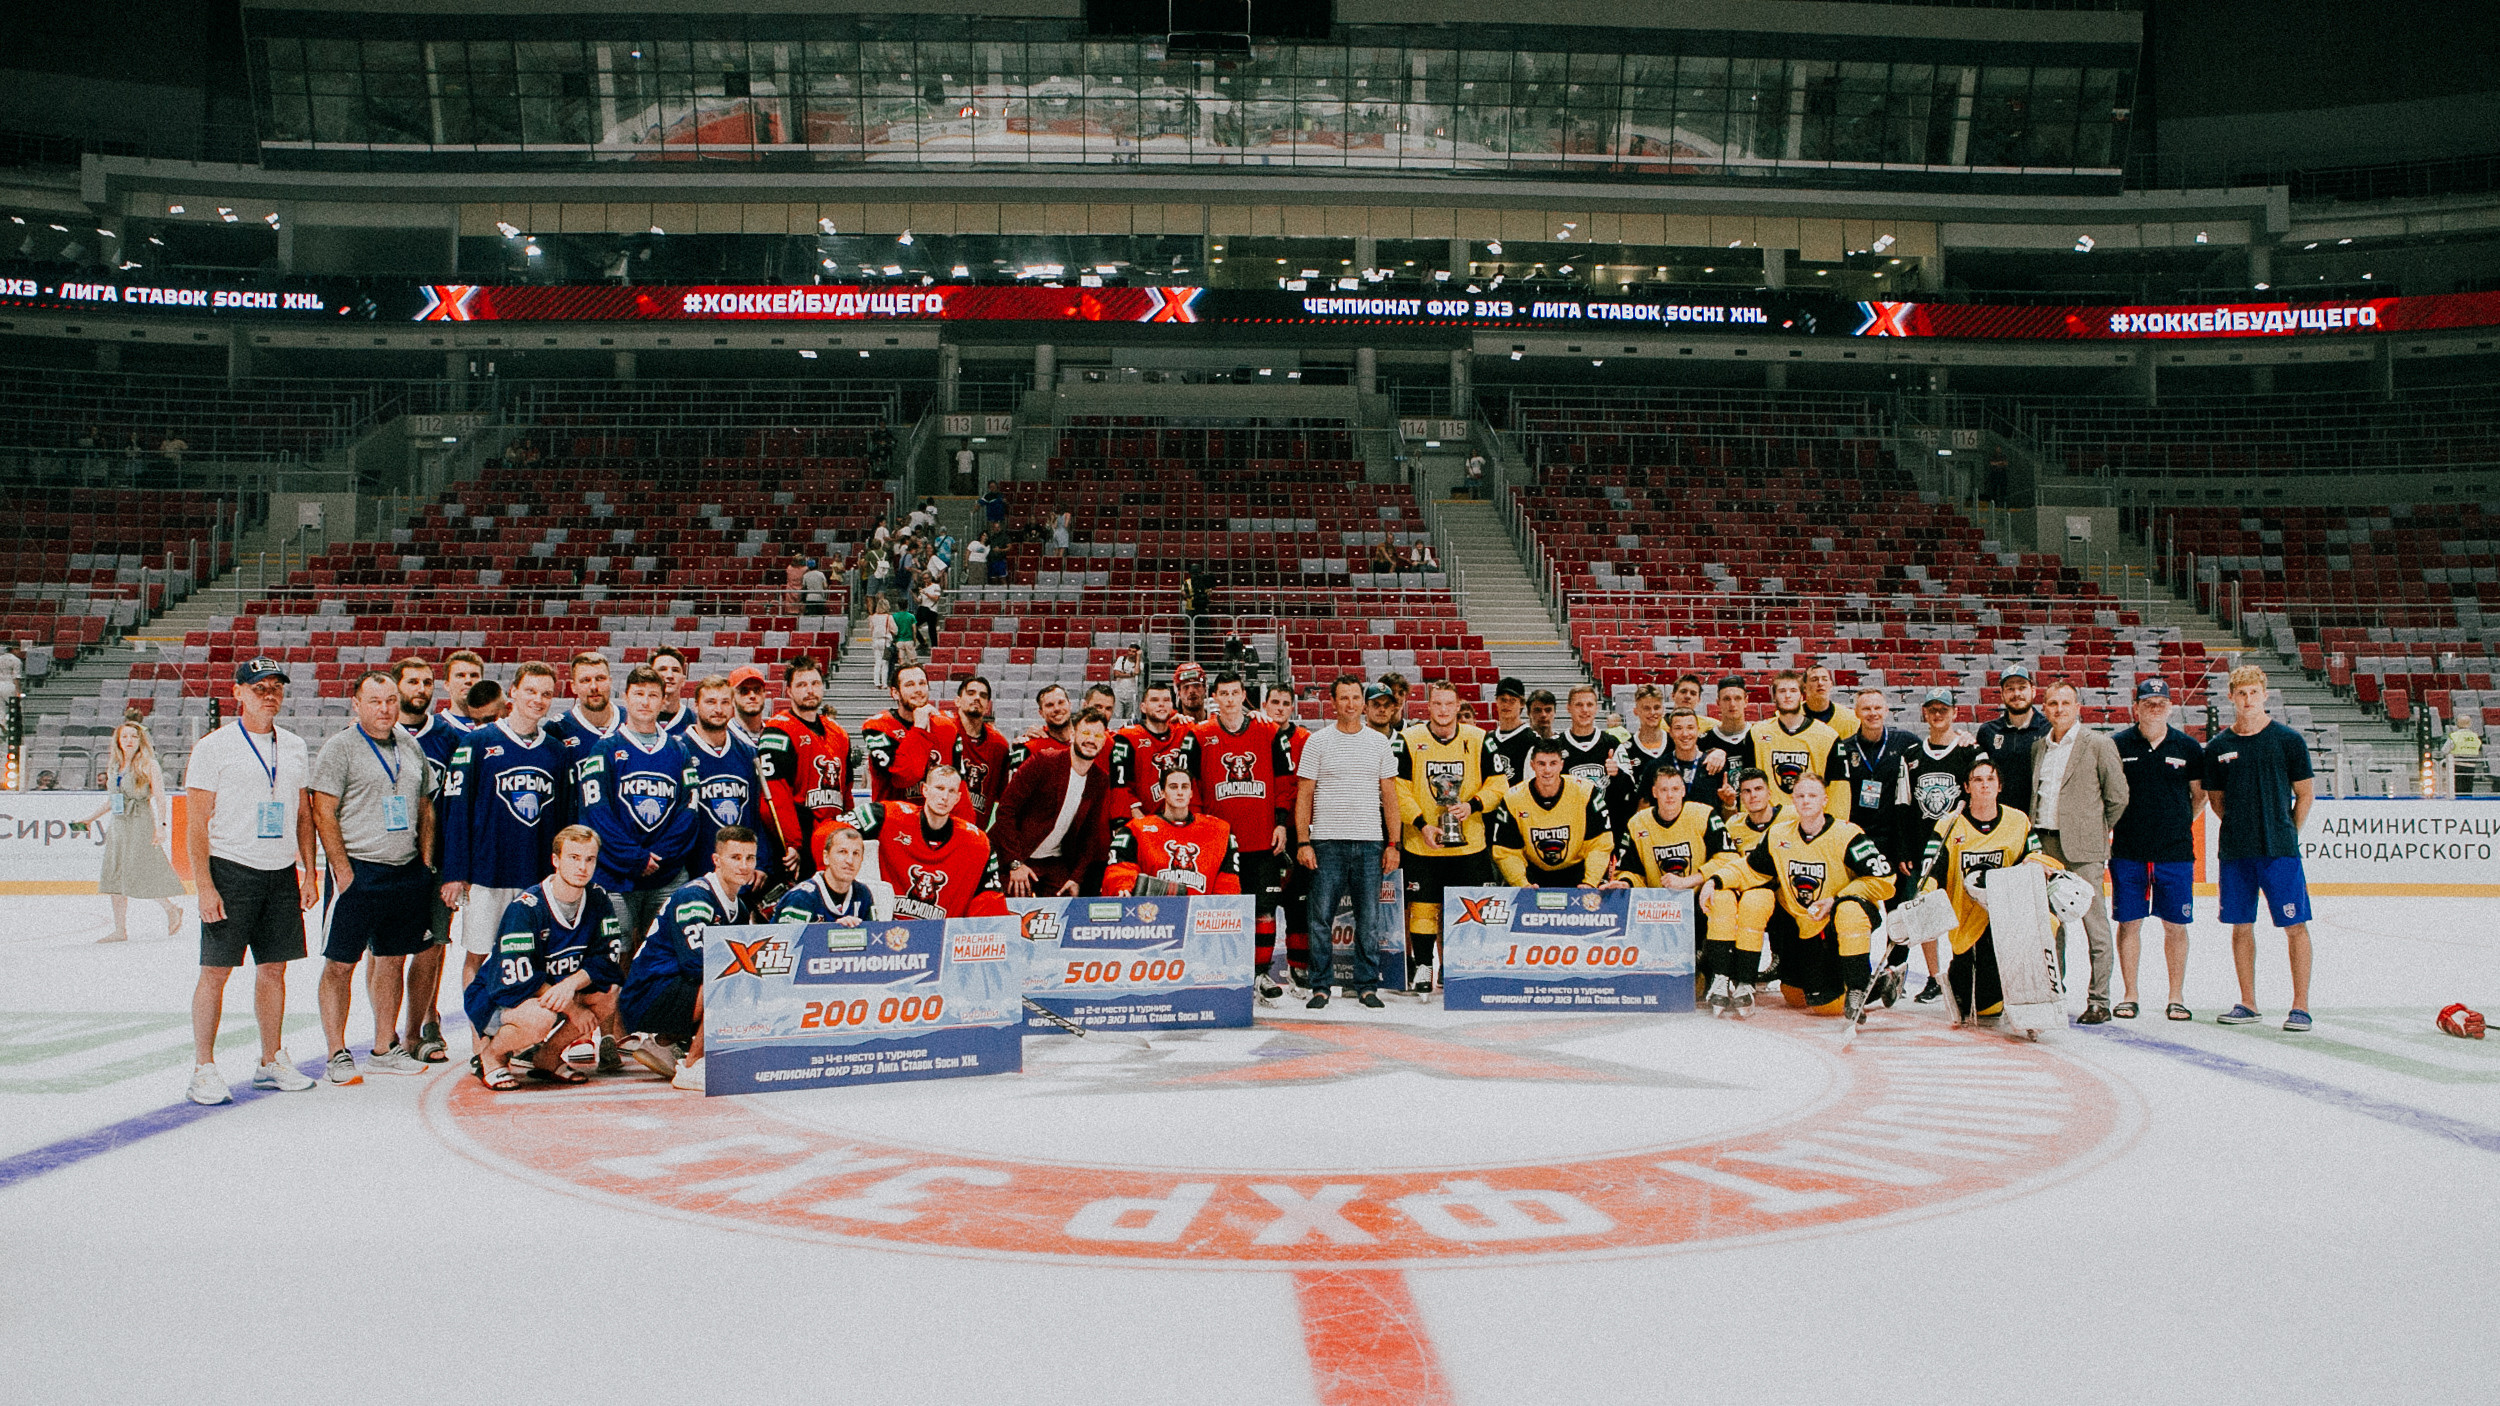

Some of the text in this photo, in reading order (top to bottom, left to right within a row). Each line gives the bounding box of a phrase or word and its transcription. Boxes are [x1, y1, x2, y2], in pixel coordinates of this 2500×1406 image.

[60, 282, 118, 302] ЛИГА
[124, 286, 207, 307] СТАВОК
[213, 291, 277, 309] SOCHI
[283, 293, 324, 309] XHL
[684, 289, 943, 316] #ХОККЕЙБУДУЩЕГО
[1304, 298, 1421, 316] ЧЕМПИОНАТ
[1427, 299, 1470, 317] ФХР
[1533, 302, 1582, 319] ЛИГА
[1587, 303, 1661, 321] СТАВОК
[1665, 305, 1725, 322] SOCHI
[1730, 306, 1767, 324] XHL
[2110, 306, 2377, 333] #ХОККЕЙБУДУЩЕГО
[946, 417, 969, 432] 113
[986, 417, 1010, 432] 114
[1402, 421, 1425, 436] 114
[1441, 421, 1465, 437] 115
[1953, 431, 1976, 446] 116
[1773, 752, 1808, 765] РОСТОВ
[1427, 762, 1464, 776] РОСТОВ
[501, 774, 552, 795] КРЫМ
[623, 779, 675, 799] КРЫМ
[701, 783, 746, 799] КРЫМ
[1217, 781, 1264, 798] КРАСНОДАР
[1532, 828, 1569, 841] РОСТОВ
[1654, 845, 1690, 861] РОСТОВ
[1963, 852, 2002, 868] РОСТОВ
[1789, 861, 1825, 878] РОСТОВ
[1866, 854, 1891, 876] 36
[1521, 912, 1618, 927] СЕРТИФИКАТ
[1637, 910, 1681, 920] МАШИНА
[1072, 924, 1176, 941] СЕРТИФИКАТ
[1195, 919, 1242, 930] МАШИНА
[955, 934, 994, 944] КРАСНАЯ
[953, 944, 1006, 958] МАШИНА
[1506, 944, 1639, 966] 1 000 000
[501, 956, 534, 985] 30
[808, 953, 930, 975] СЕРТИФИКАТ
[1064, 959, 1186, 983] 500 000
[2044, 948, 2060, 994] CCM
[1535, 986, 1547, 994] 1-е
[1580, 987, 1614, 995] турнире
[1481, 995, 1533, 1004] ЧЕМПИОНАТ
[1533, 995, 1553, 1004] ФХР
[801, 994, 944, 1029] 200 000
[1086, 1006, 1100, 1014] 2-е
[1101, 1006, 1128, 1014] место
[1136, 1004, 1173, 1014] турнире
[1085, 1016, 1106, 1025] ФХР
[1200, 1011, 1216, 1021] XHL
[719, 1023, 772, 1036] на сумму
[811, 1048, 928, 1065] за 4-е место в турнире
[755, 1067, 824, 1082] ЧЕМПИОНАТ
[825, 1066, 851, 1077] ФХР
[961, 1055, 979, 1067] XHL
